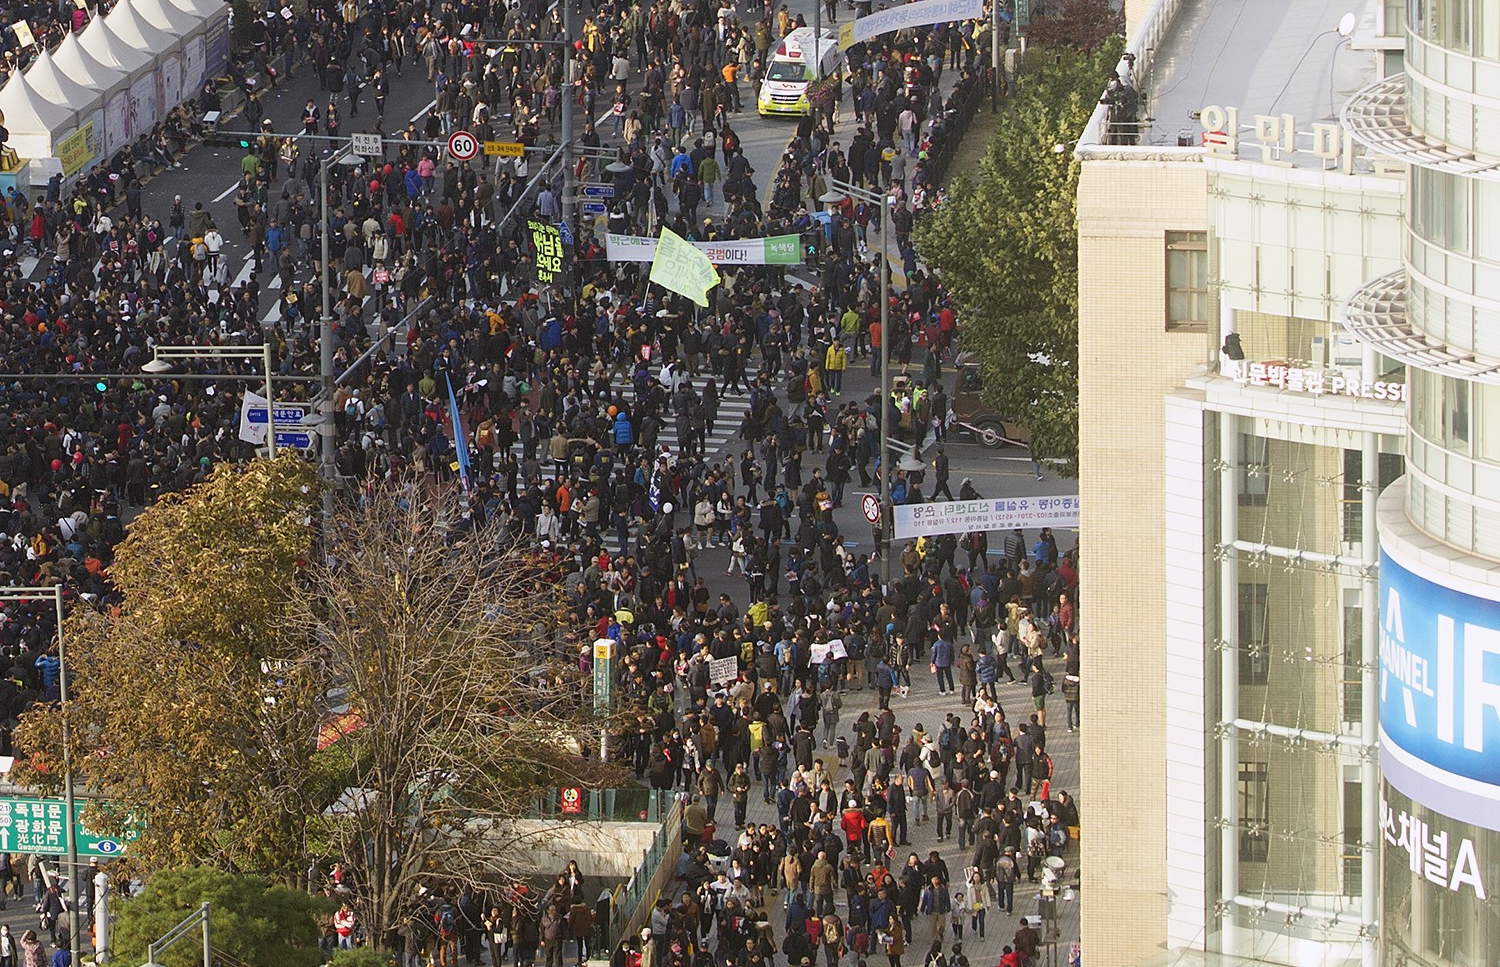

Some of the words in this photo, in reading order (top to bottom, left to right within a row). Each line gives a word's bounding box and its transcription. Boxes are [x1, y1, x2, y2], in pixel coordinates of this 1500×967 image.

[354, 144, 381, 154] 직좌신호
[454, 140, 472, 152] 60
[609, 235, 650, 246] 박근혜는
[769, 242, 795, 252] 녹색당
[706, 248, 747, 261] 공범이다!
[1233, 360, 1324, 394] 신문박물관
[15, 803, 62, 817] 독립문
[15, 819, 62, 834] 광화문
[17, 833, 59, 845] 光化門
[17, 844, 65, 853] Gwanghwamun
[103, 841, 111, 851] 6
